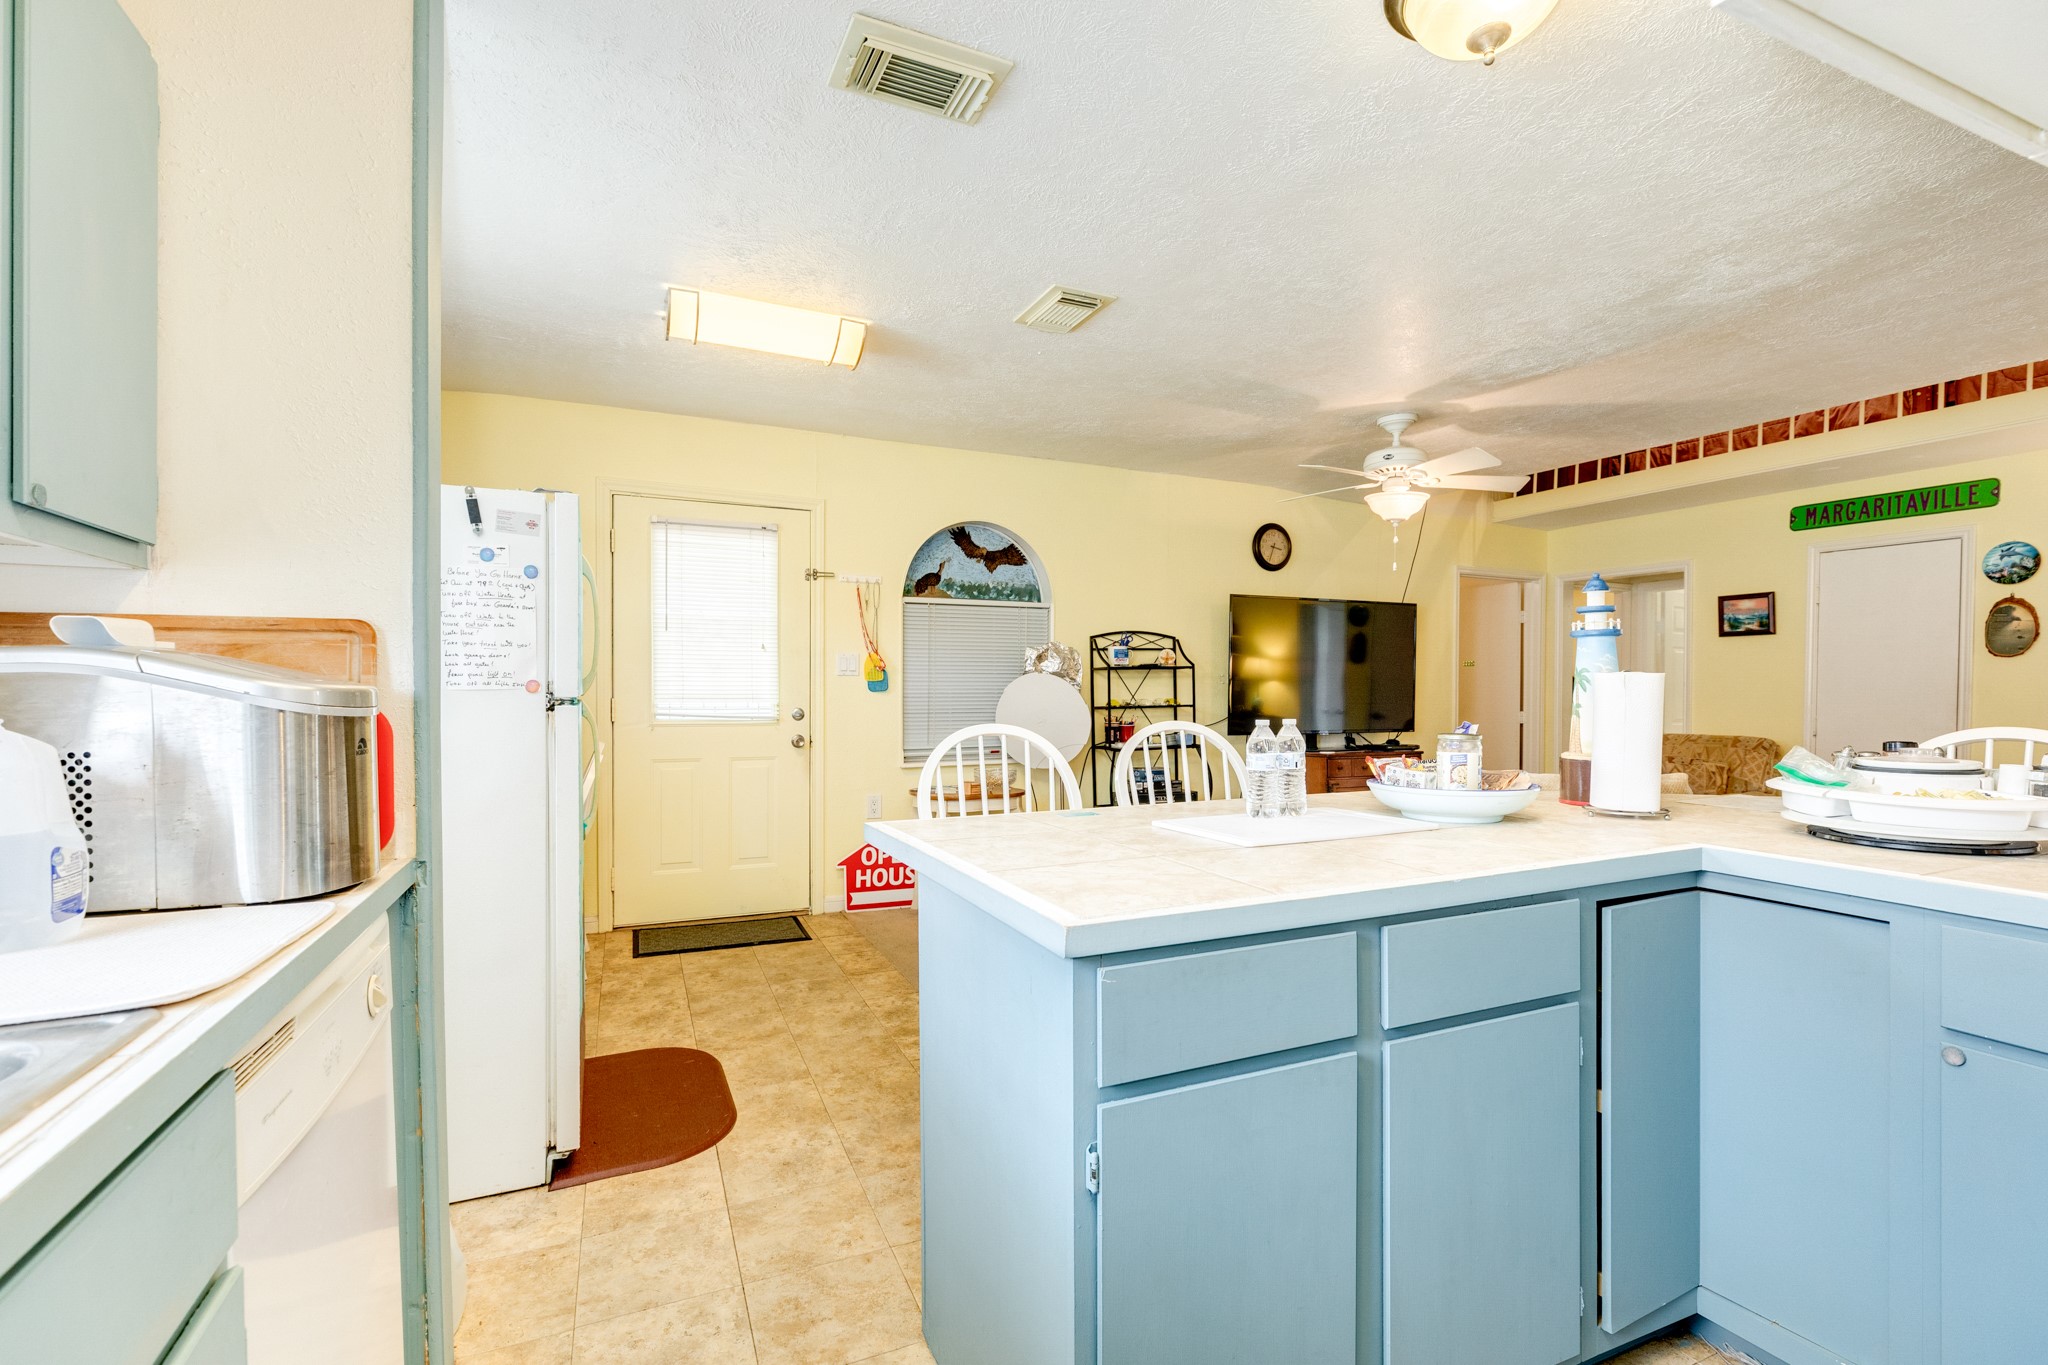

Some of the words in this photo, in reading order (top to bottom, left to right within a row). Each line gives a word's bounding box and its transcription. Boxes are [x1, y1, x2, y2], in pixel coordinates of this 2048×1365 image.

[1805, 484, 1980, 526] MARGARITAVILLE
[861, 847, 902, 866] OP
[855, 866, 916, 889] HOUS
